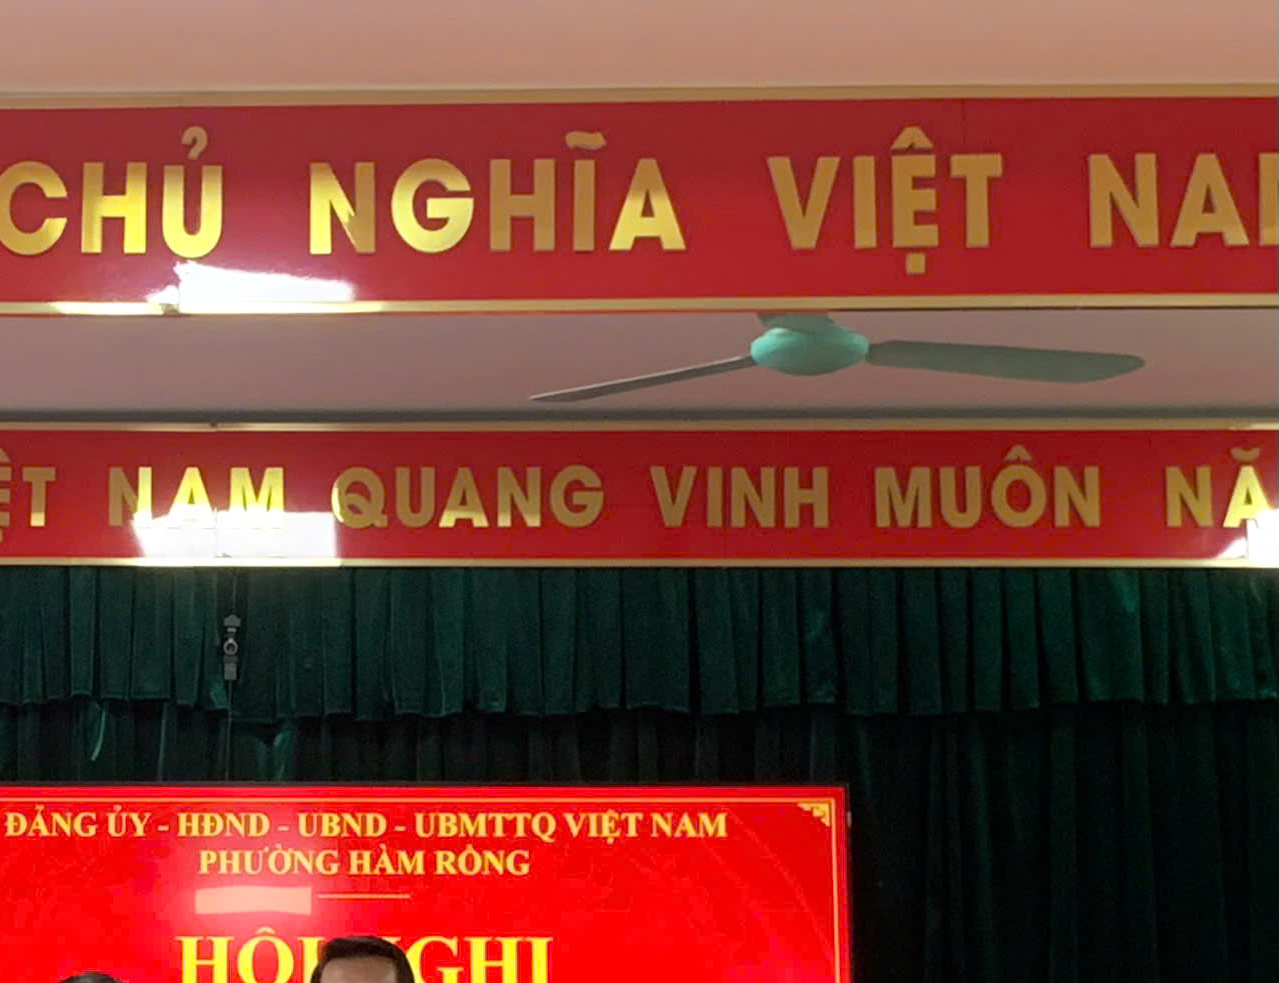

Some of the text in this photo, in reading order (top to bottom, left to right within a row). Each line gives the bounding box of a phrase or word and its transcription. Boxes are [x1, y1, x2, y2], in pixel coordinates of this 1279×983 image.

[308, 131, 687, 256] NGHĨA
[767, 126, 1002, 274] VIỆT
[109, 466, 285, 529] NAM
[329, 466, 604, 529] QUANG
[651, 466, 828, 528] VINH
[875, 446, 1101, 528] MUÔN
[1166, 447, 1275, 529] NĂ
[5, 805, 97, 837] ĐẢNG
[107, 805, 152, 837] ỦY
[177, 812, 270, 838] HĐND
[298, 812, 387, 838] UBND
[415, 812, 557, 842] UBMTTQ
[564, 809, 644, 844] VIỆT
[651, 812, 727, 838] NAM
[198, 844, 340, 875] PHƯỜNG
[348, 843, 425, 875] HÀM
